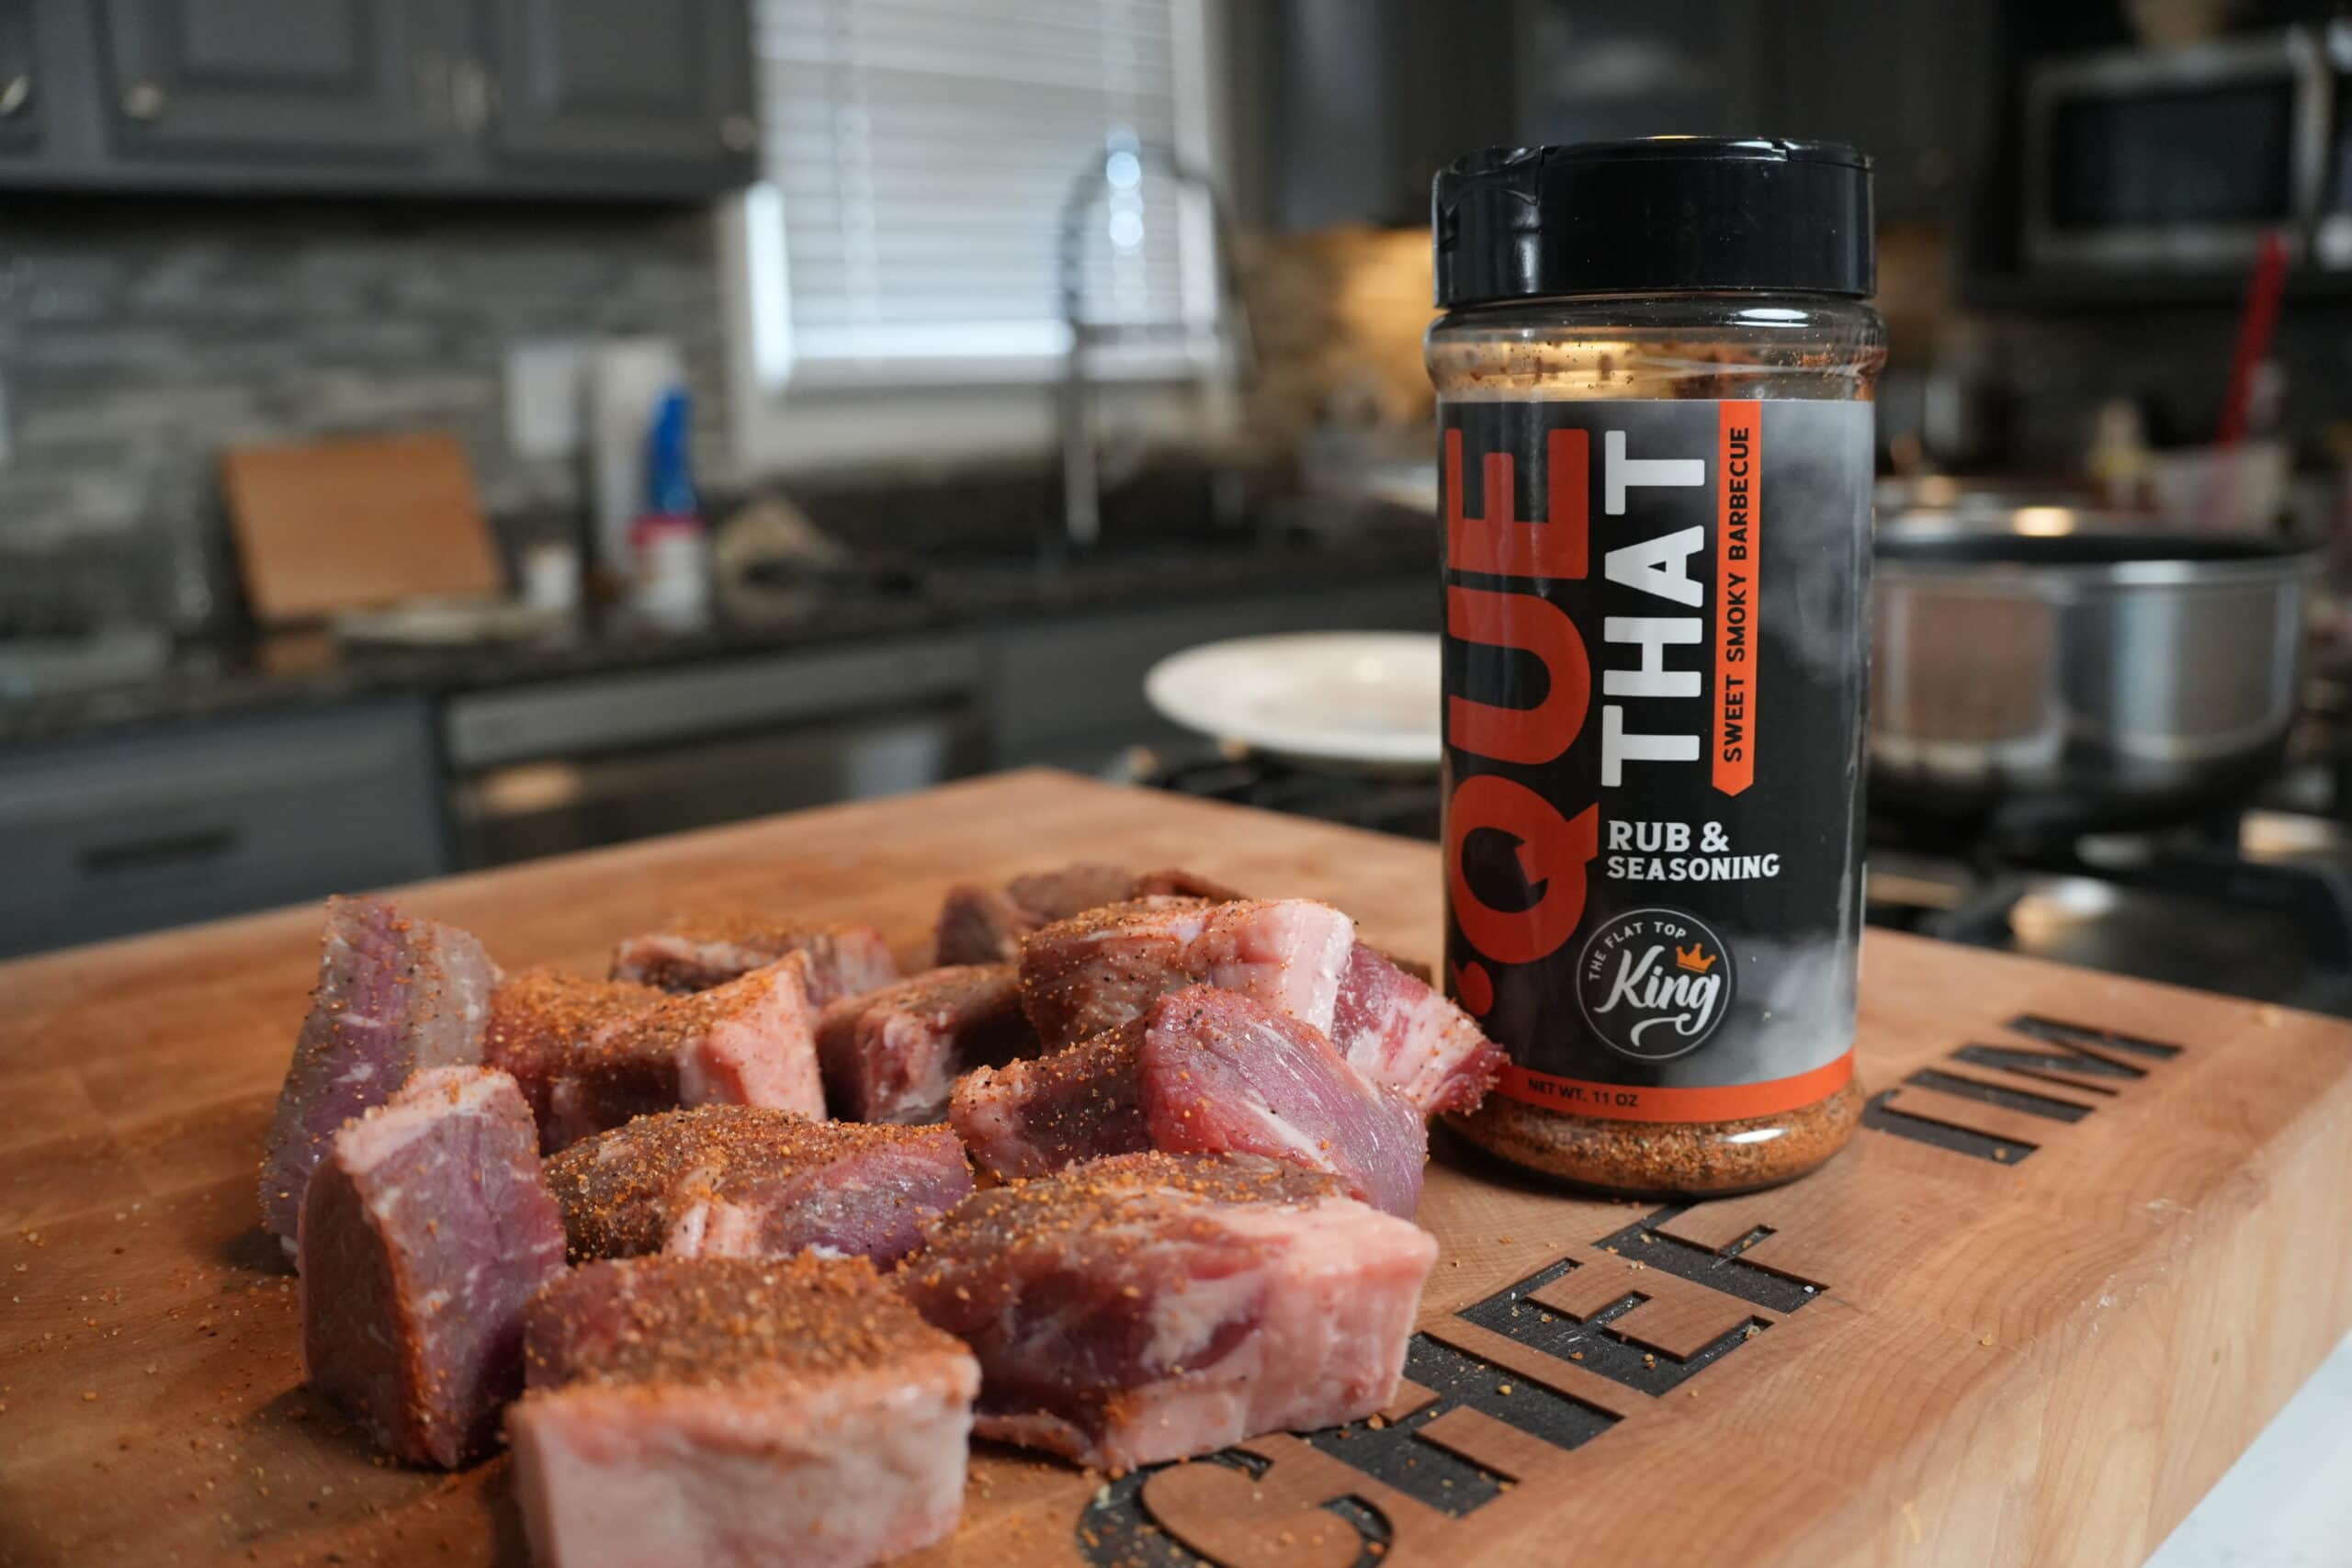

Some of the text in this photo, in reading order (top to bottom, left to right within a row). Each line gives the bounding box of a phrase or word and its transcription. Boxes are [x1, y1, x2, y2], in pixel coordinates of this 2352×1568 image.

[1601, 430, 1705, 787] THAT
[1723, 427, 1749, 762] SWEET SMOKY BARBECUE
[1607, 853, 1781, 882] SEASONING
[1608, 819, 1730, 853] RUB &
[1589, 921, 1687, 981] THE FLAT TOP
[1593, 944, 1722, 1047] King
[1528, 1077, 1638, 1107] NET WT. 11 OZ
[1073, 1013, 2185, 1568] CHEF TIM
